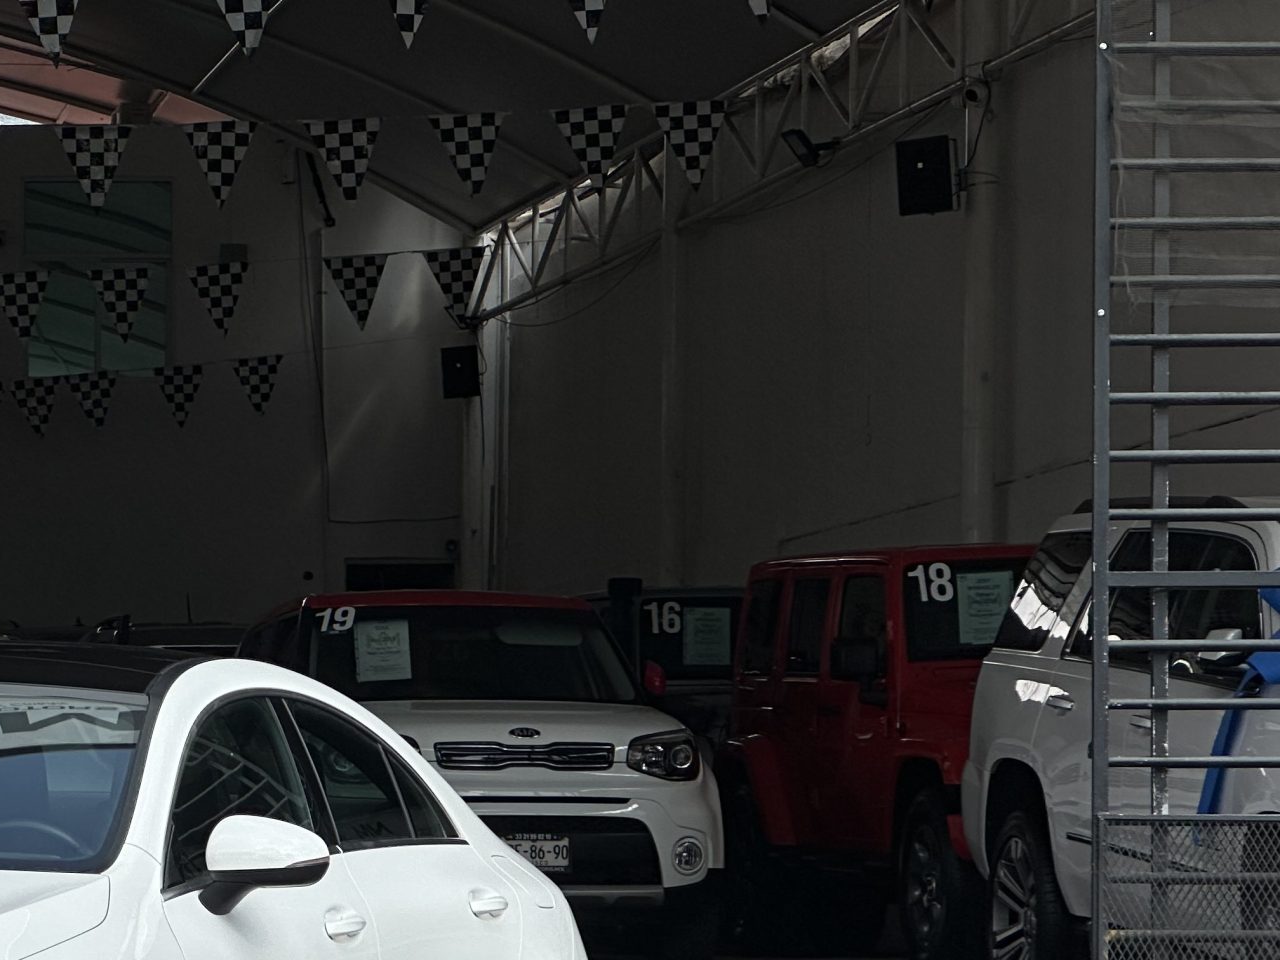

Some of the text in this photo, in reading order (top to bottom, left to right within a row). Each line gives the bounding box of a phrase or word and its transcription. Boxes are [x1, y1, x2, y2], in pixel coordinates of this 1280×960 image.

[907, 562, 954, 602] 18
[314, 606, 356, 632] 19
[643, 601, 682, 634] 16
